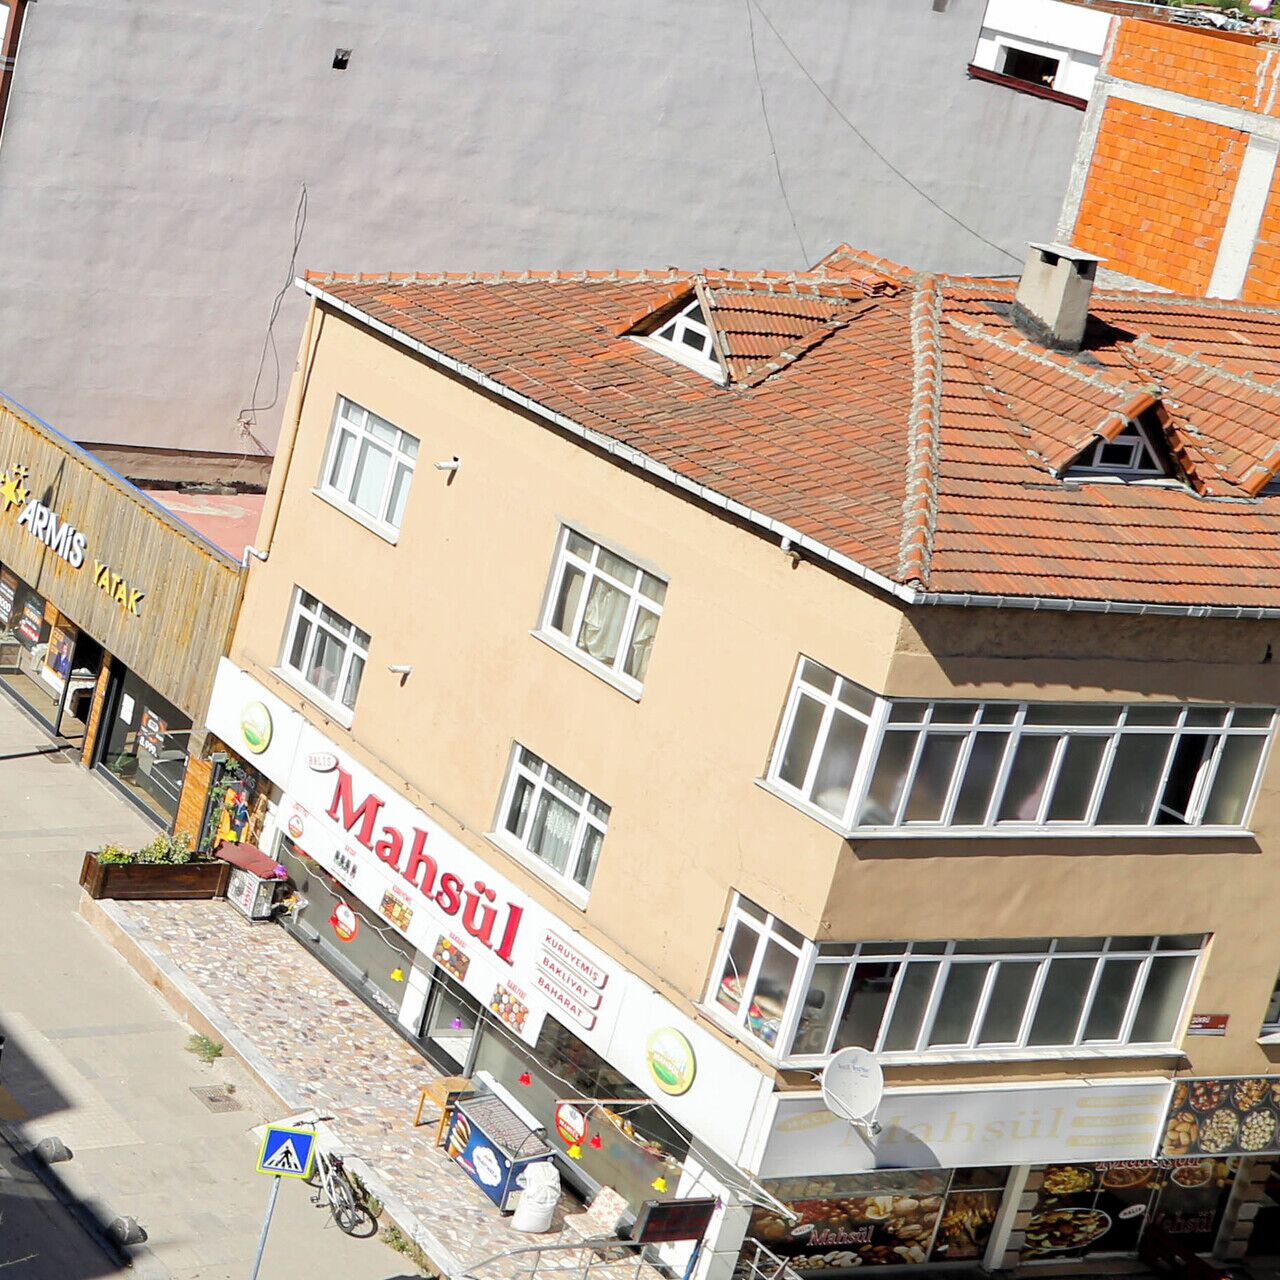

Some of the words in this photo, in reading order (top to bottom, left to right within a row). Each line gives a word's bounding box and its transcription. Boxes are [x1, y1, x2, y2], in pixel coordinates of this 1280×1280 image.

[93, 559, 145, 617] YATAK
[324, 766, 524, 967] Mahsül
[542, 956, 589, 999] BAKLİYAT
[544, 934, 600, 983] KURUYEMİŞ
[537, 977, 583, 1018] BAHARAT
[806, 1224, 875, 1246] Mahsül
